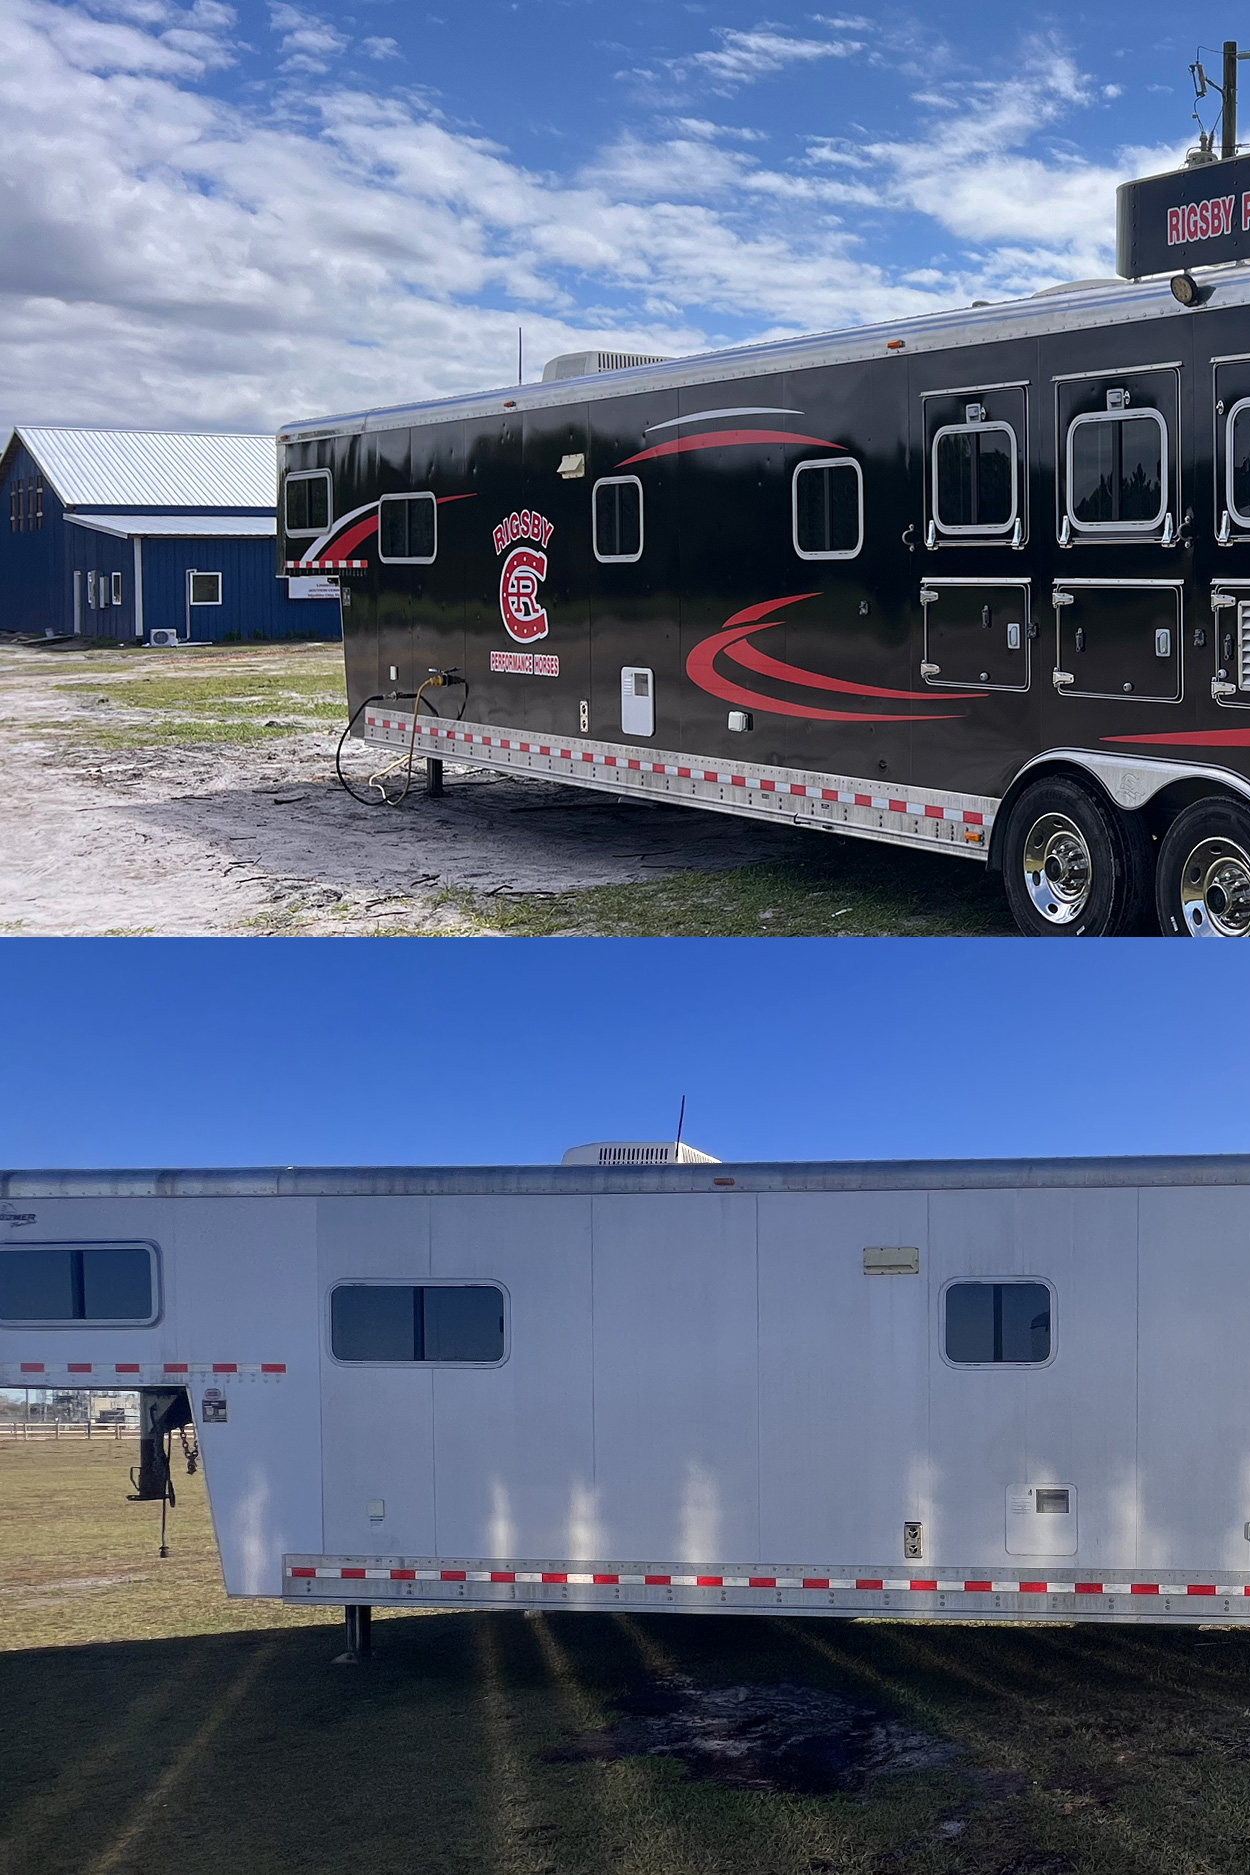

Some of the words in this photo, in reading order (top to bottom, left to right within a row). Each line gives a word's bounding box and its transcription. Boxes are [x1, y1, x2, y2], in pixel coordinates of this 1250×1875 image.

[1168, 195, 1235, 245] RIGSBY
[493, 509, 554, 555] RIGSBY
[490, 651, 533, 675] PERFORMANCE
[534, 654, 560, 677] HORSES
